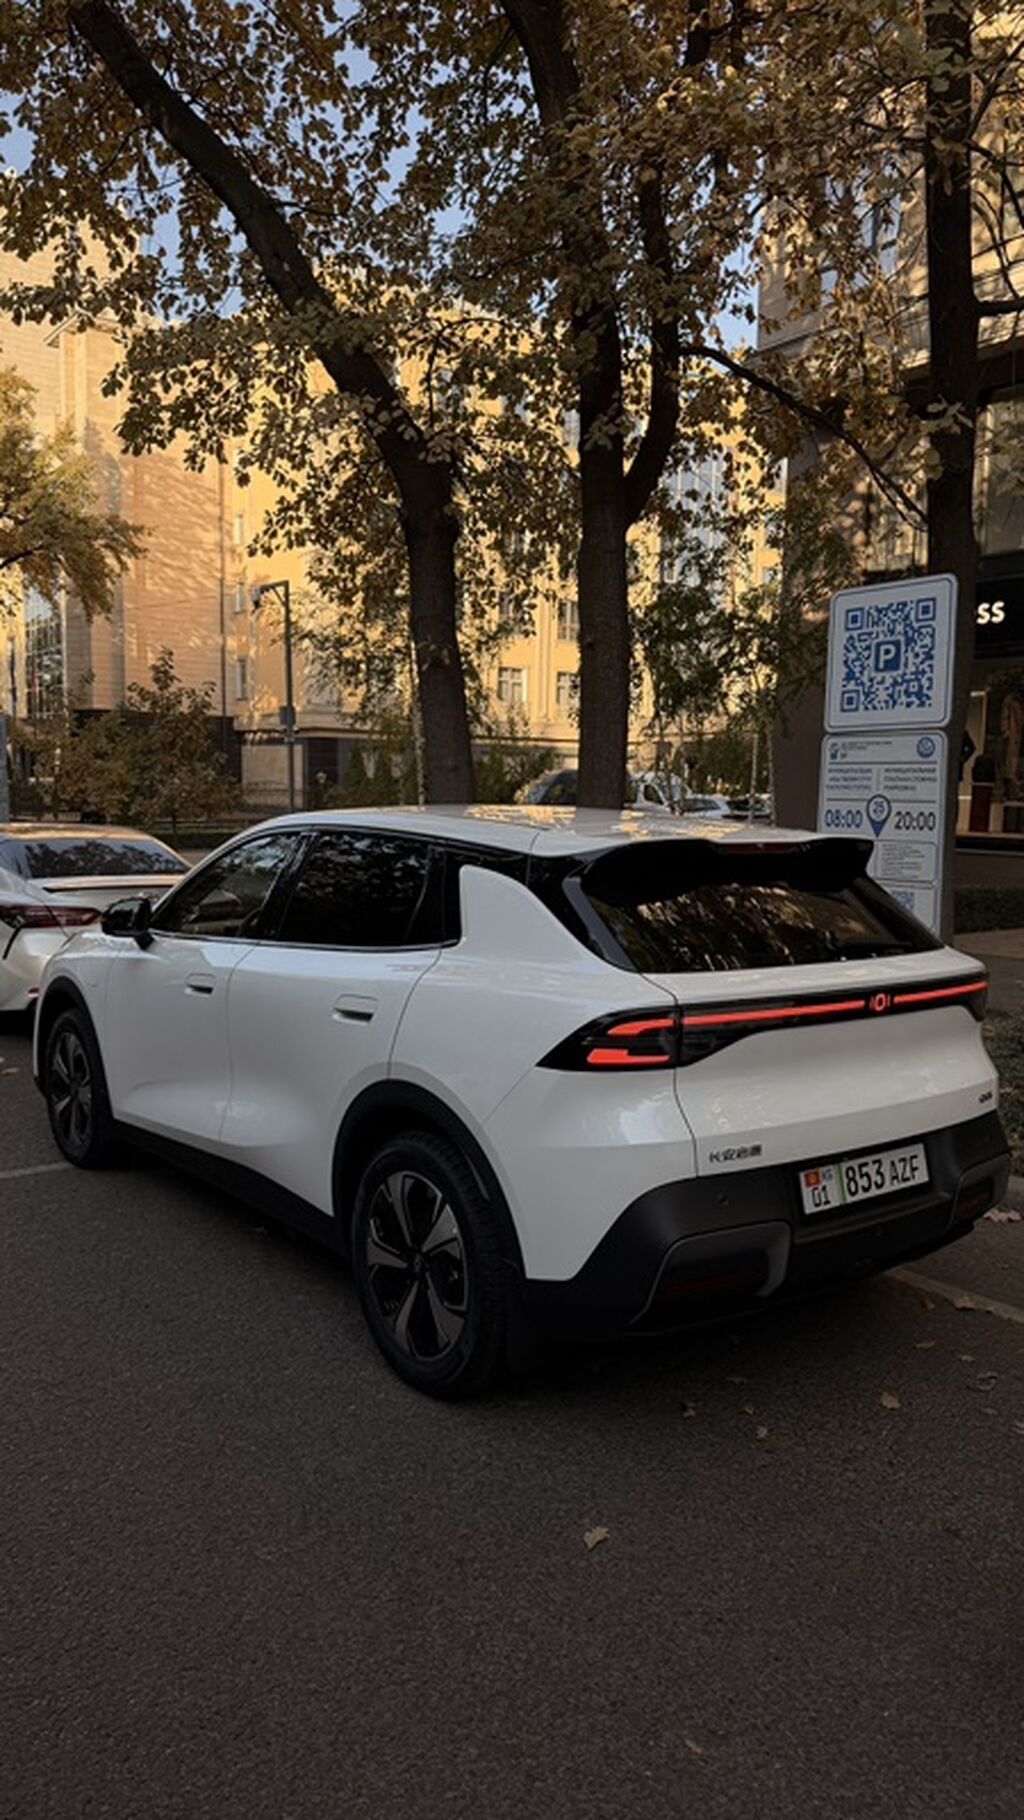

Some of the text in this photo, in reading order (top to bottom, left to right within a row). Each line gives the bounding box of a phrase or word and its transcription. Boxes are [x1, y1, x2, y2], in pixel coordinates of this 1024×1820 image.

[878, 643, 897, 669] P
[825, 808, 864, 829] 08:00
[894, 810, 937, 832] 20:00
[845, 1154, 920, 1197] 853 AZF
[811, 1185, 831, 1208] 01
